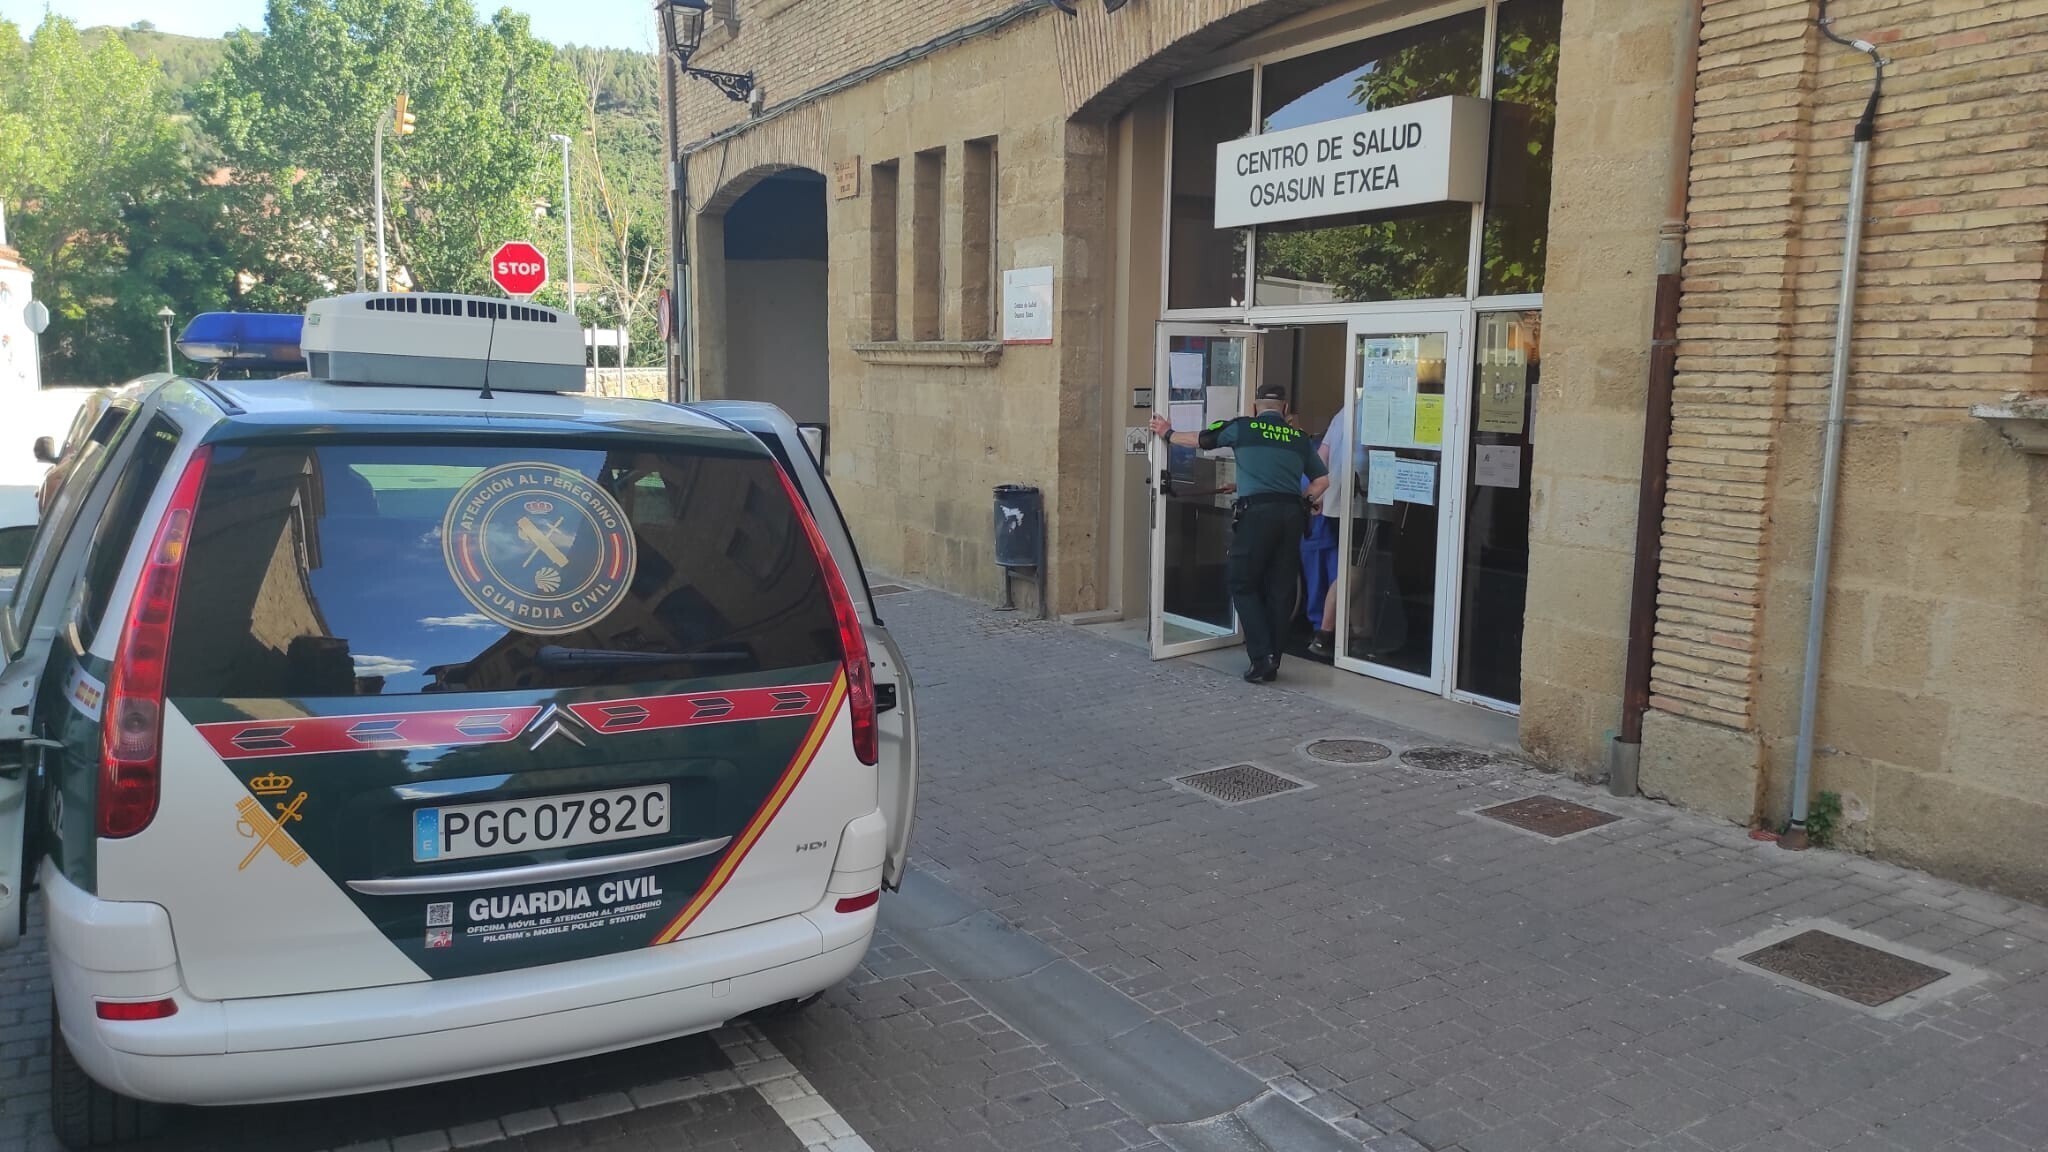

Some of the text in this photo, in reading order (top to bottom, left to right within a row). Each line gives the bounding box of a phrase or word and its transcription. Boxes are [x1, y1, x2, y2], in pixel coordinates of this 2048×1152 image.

[1237, 122, 1422, 177] CENTRO DE SALUD
[1250, 164, 1400, 207] OSASUN ETXEA
[498, 261, 541, 276] STOP
[1250, 422, 1301, 437] GUARDIA
[1263, 431, 1291, 442] CIVIL
[460, 474, 617, 530] ATENCIÓN AL PEREGRINO
[481, 582, 612, 619] GUARDIA CIVIL
[423, 791, 665, 852] E PGC0782C
[796, 840, 827, 853] HDI
[469, 875, 662, 921] GUARDIA CIVIL
[466, 923, 506, 934] OFICINA
[508, 919, 537, 929] MÓVIL
[540, 917, 553, 925] DE
[614, 900, 662, 913] PEREGRINO
[533, 925, 570, 937] MOBILE
[571, 920, 605, 931] POLICE
[609, 913, 646, 925] STATION
